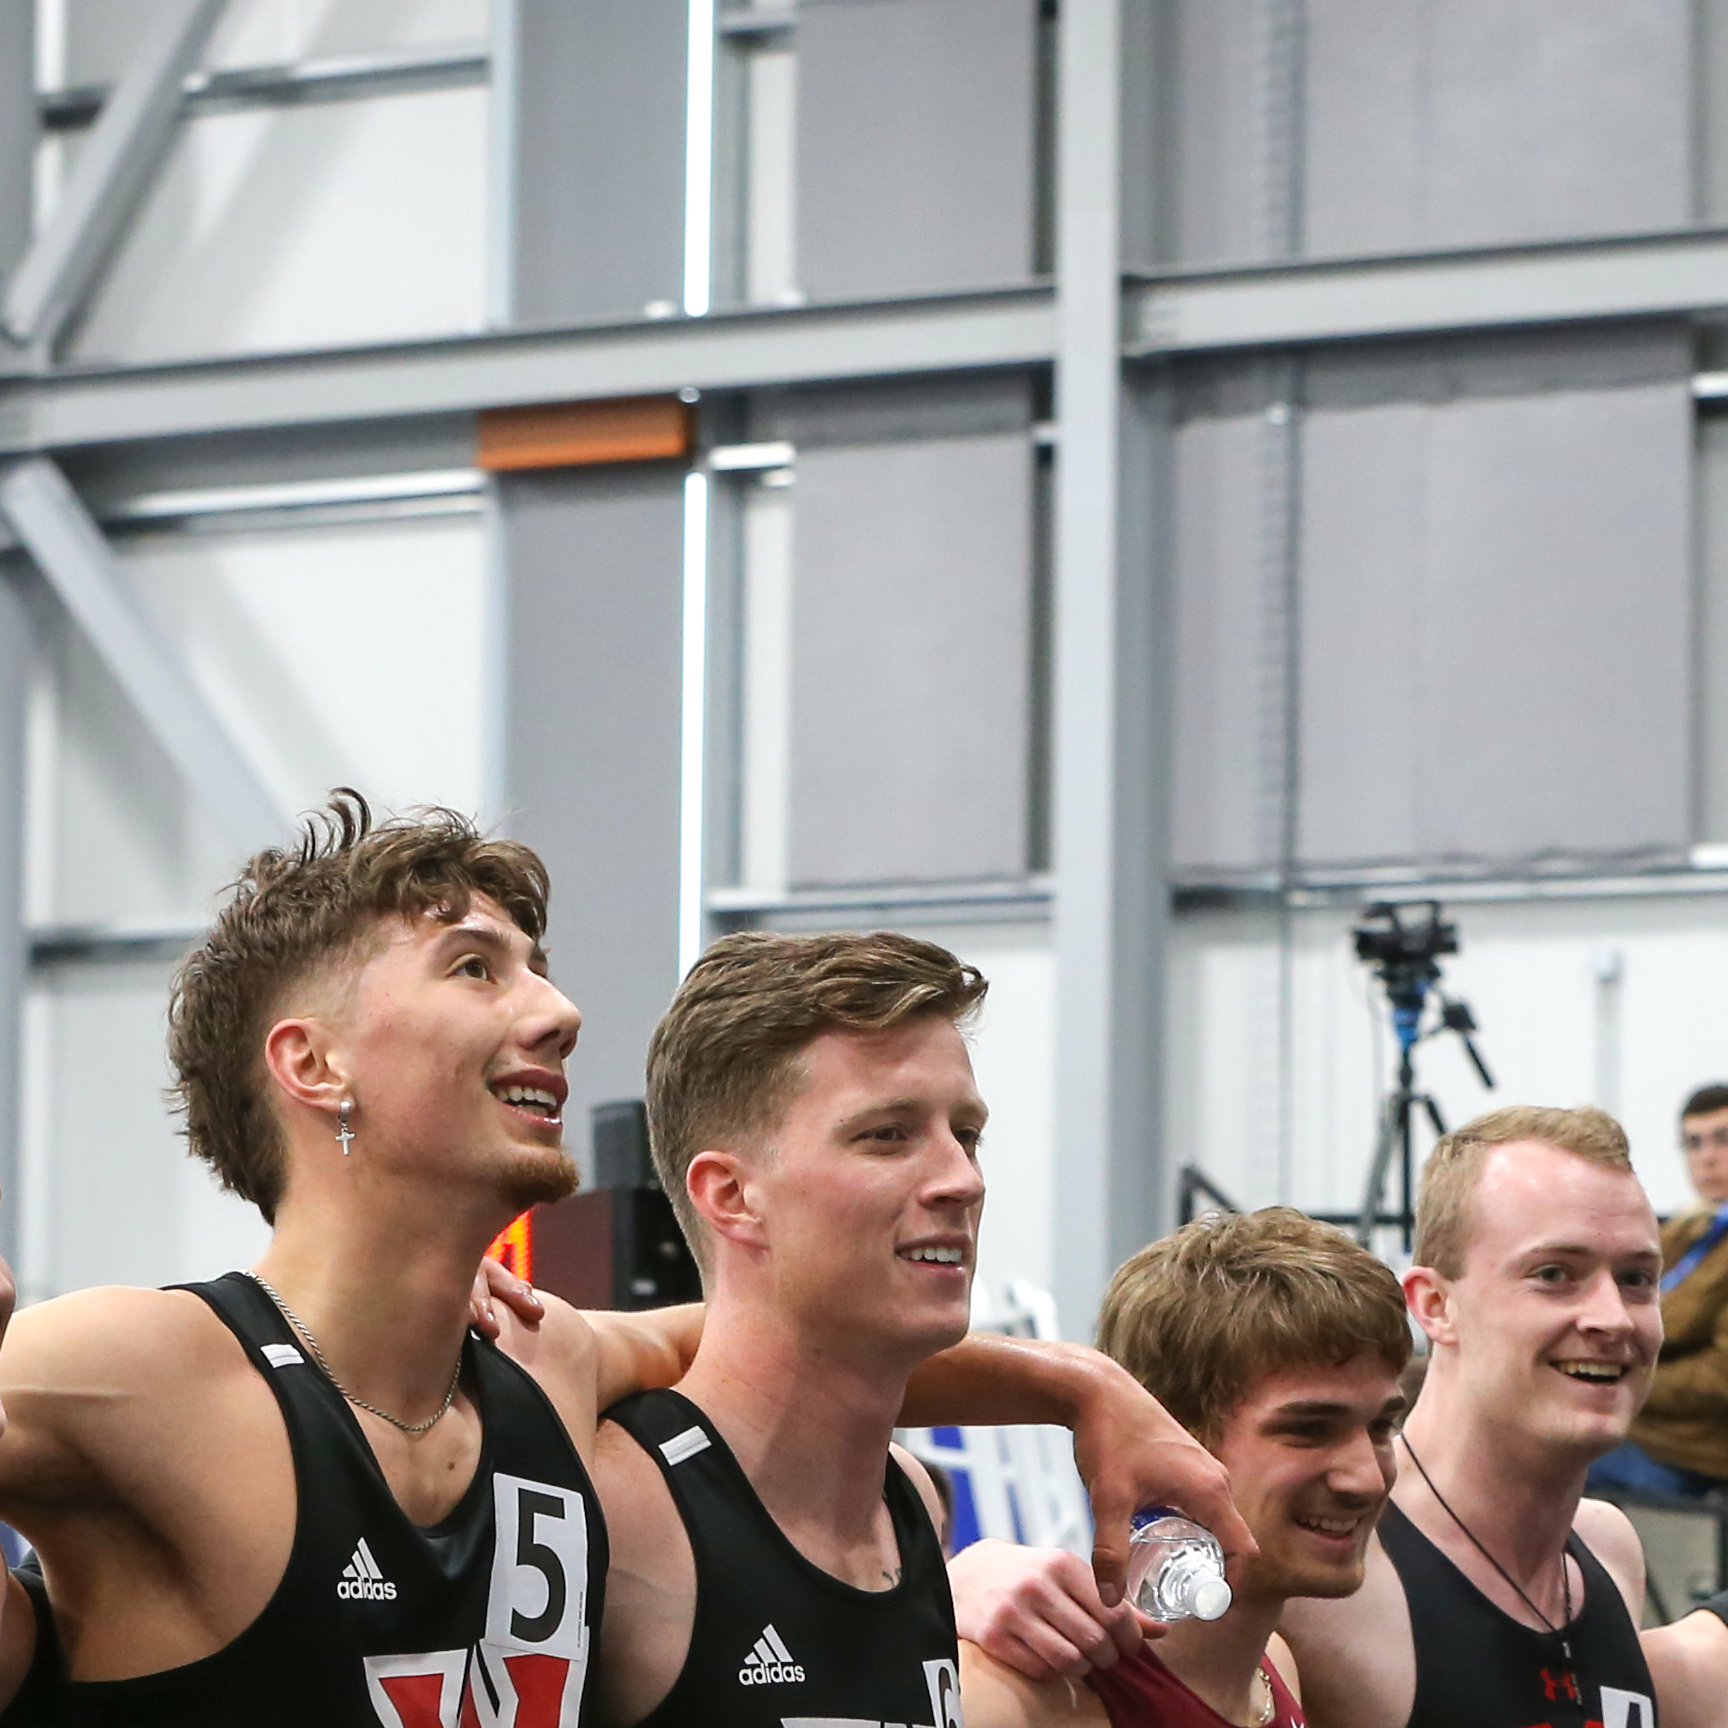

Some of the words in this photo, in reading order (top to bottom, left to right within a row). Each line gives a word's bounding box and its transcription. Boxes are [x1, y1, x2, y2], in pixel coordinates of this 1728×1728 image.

[510, 1487, 566, 1643] 5
[336, 1577, 398, 1601] adidas
[738, 1662, 806, 1686] adidas
